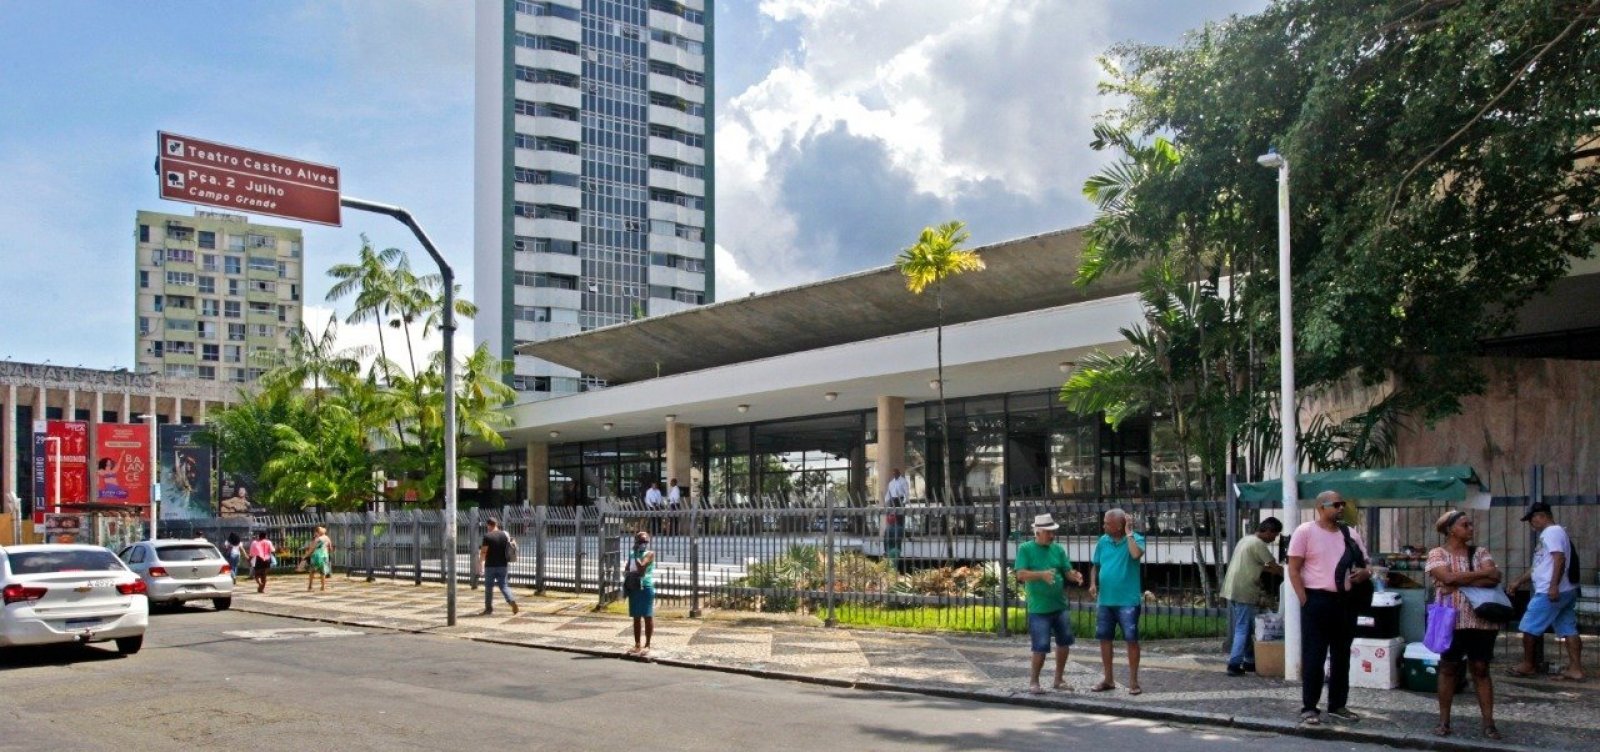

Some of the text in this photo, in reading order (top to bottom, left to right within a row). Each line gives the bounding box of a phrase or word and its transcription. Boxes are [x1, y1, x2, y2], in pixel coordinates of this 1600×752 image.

[188, 146, 335, 184] Teatro Castro Alves
[188, 170, 285, 197] Pça. 2 Julho
[189, 187, 277, 209] Campo Grande
